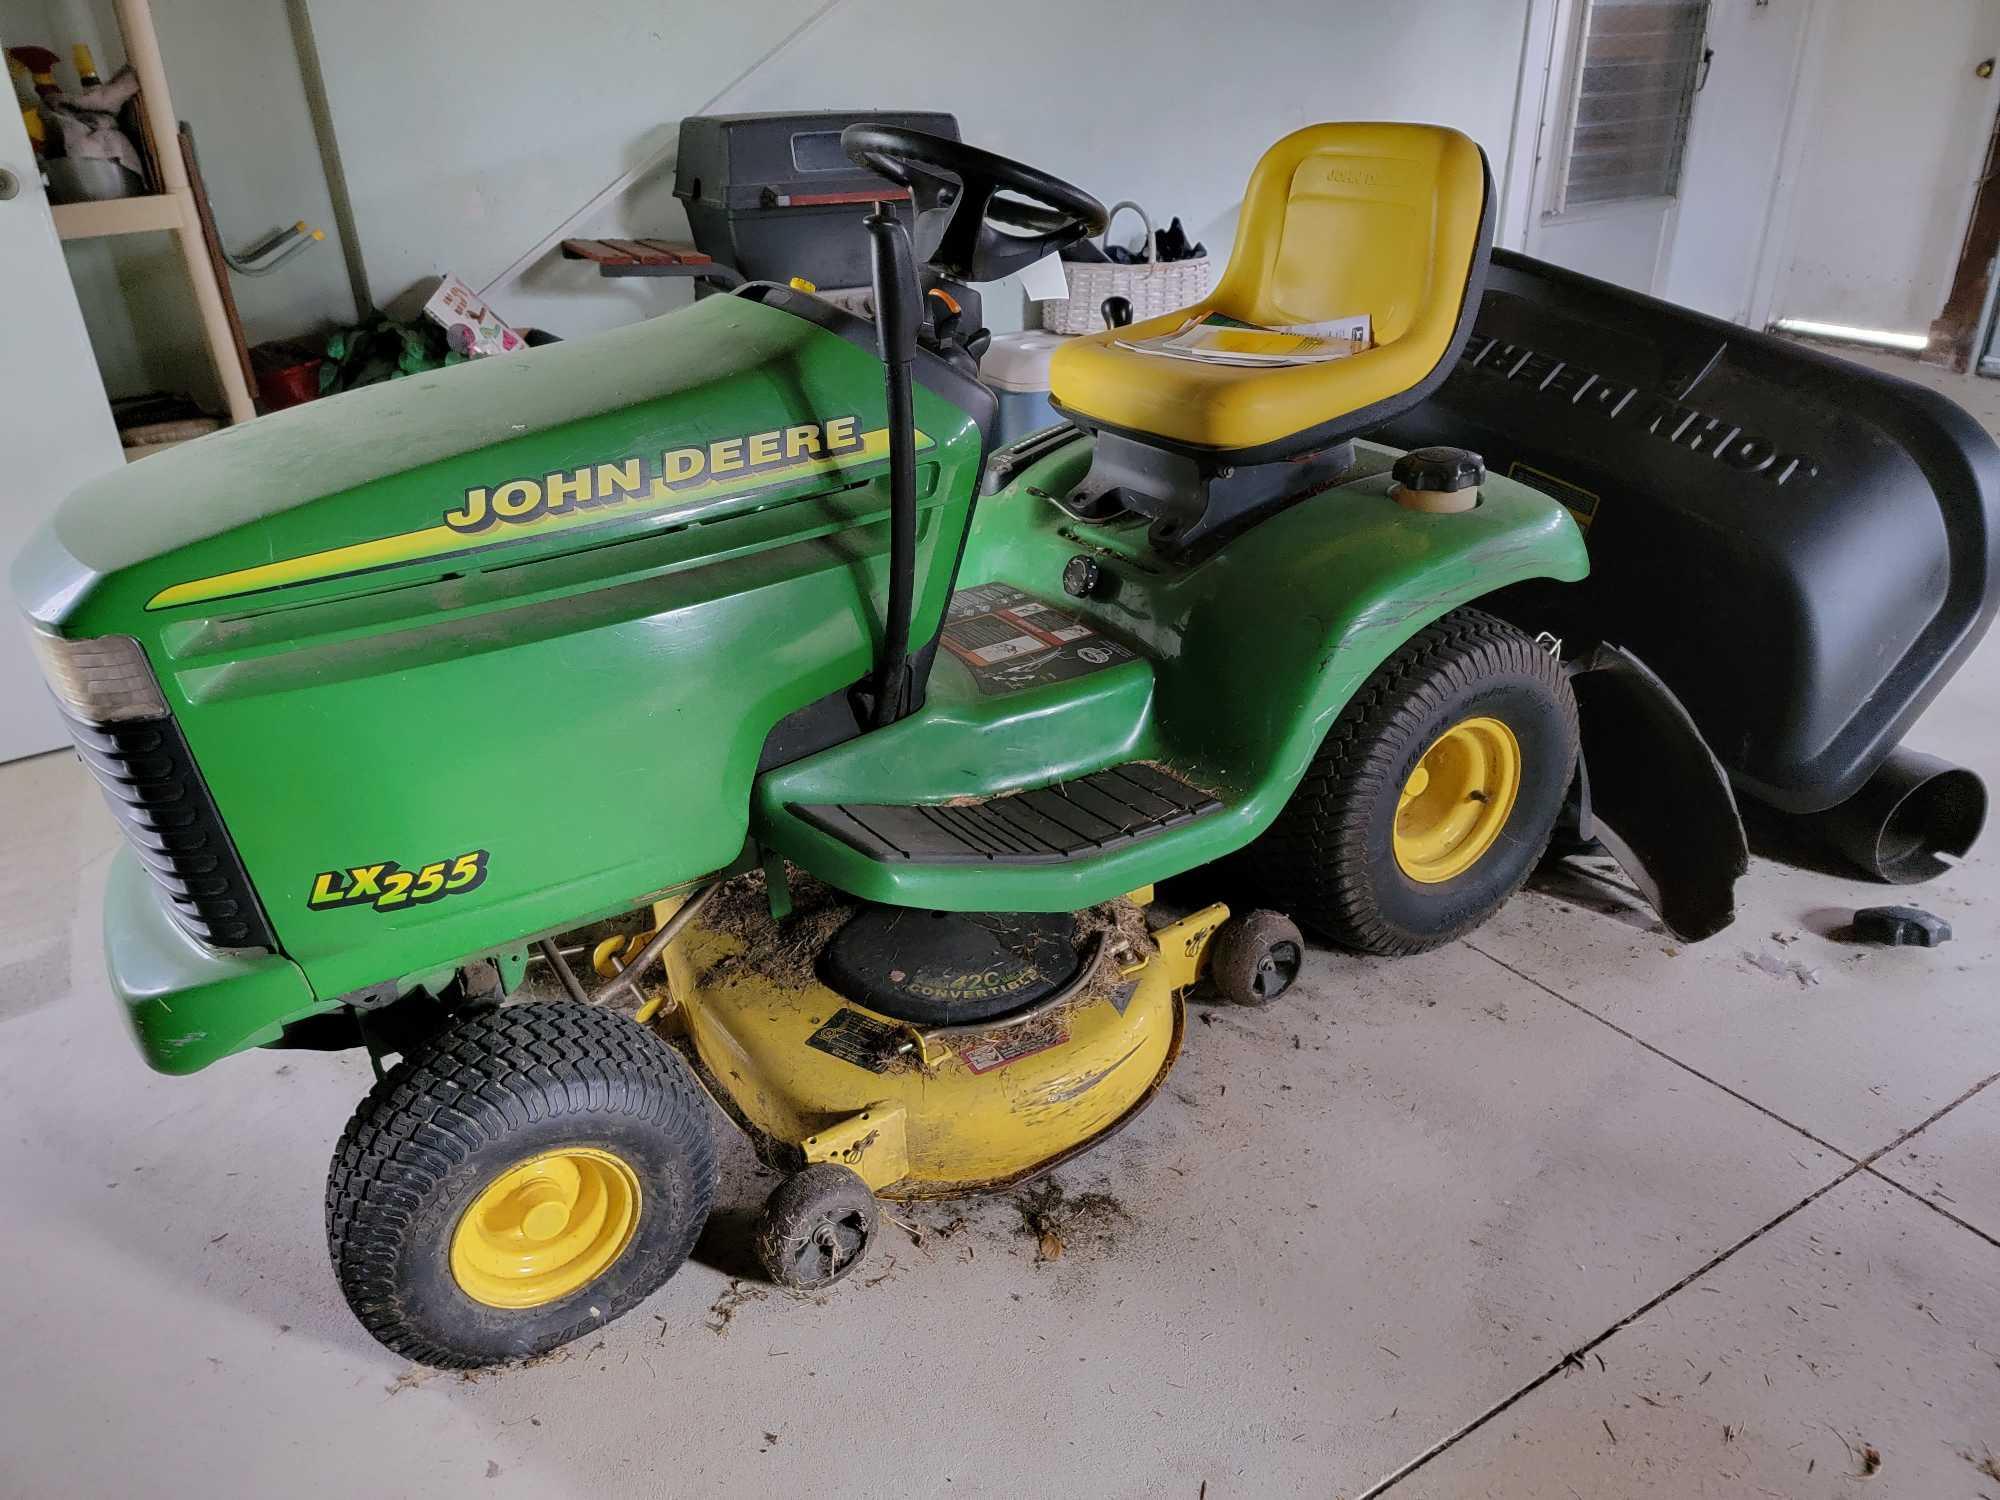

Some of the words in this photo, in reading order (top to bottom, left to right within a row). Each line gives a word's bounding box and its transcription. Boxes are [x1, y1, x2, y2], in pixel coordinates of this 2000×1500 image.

[445, 458, 648, 531] JOHN
[662, 416, 863, 488] DEERE
[308, 850, 488, 912] LX255
[909, 968, 1039, 998] CONVERTIBLE
[949, 970, 1001, 990] 42C
